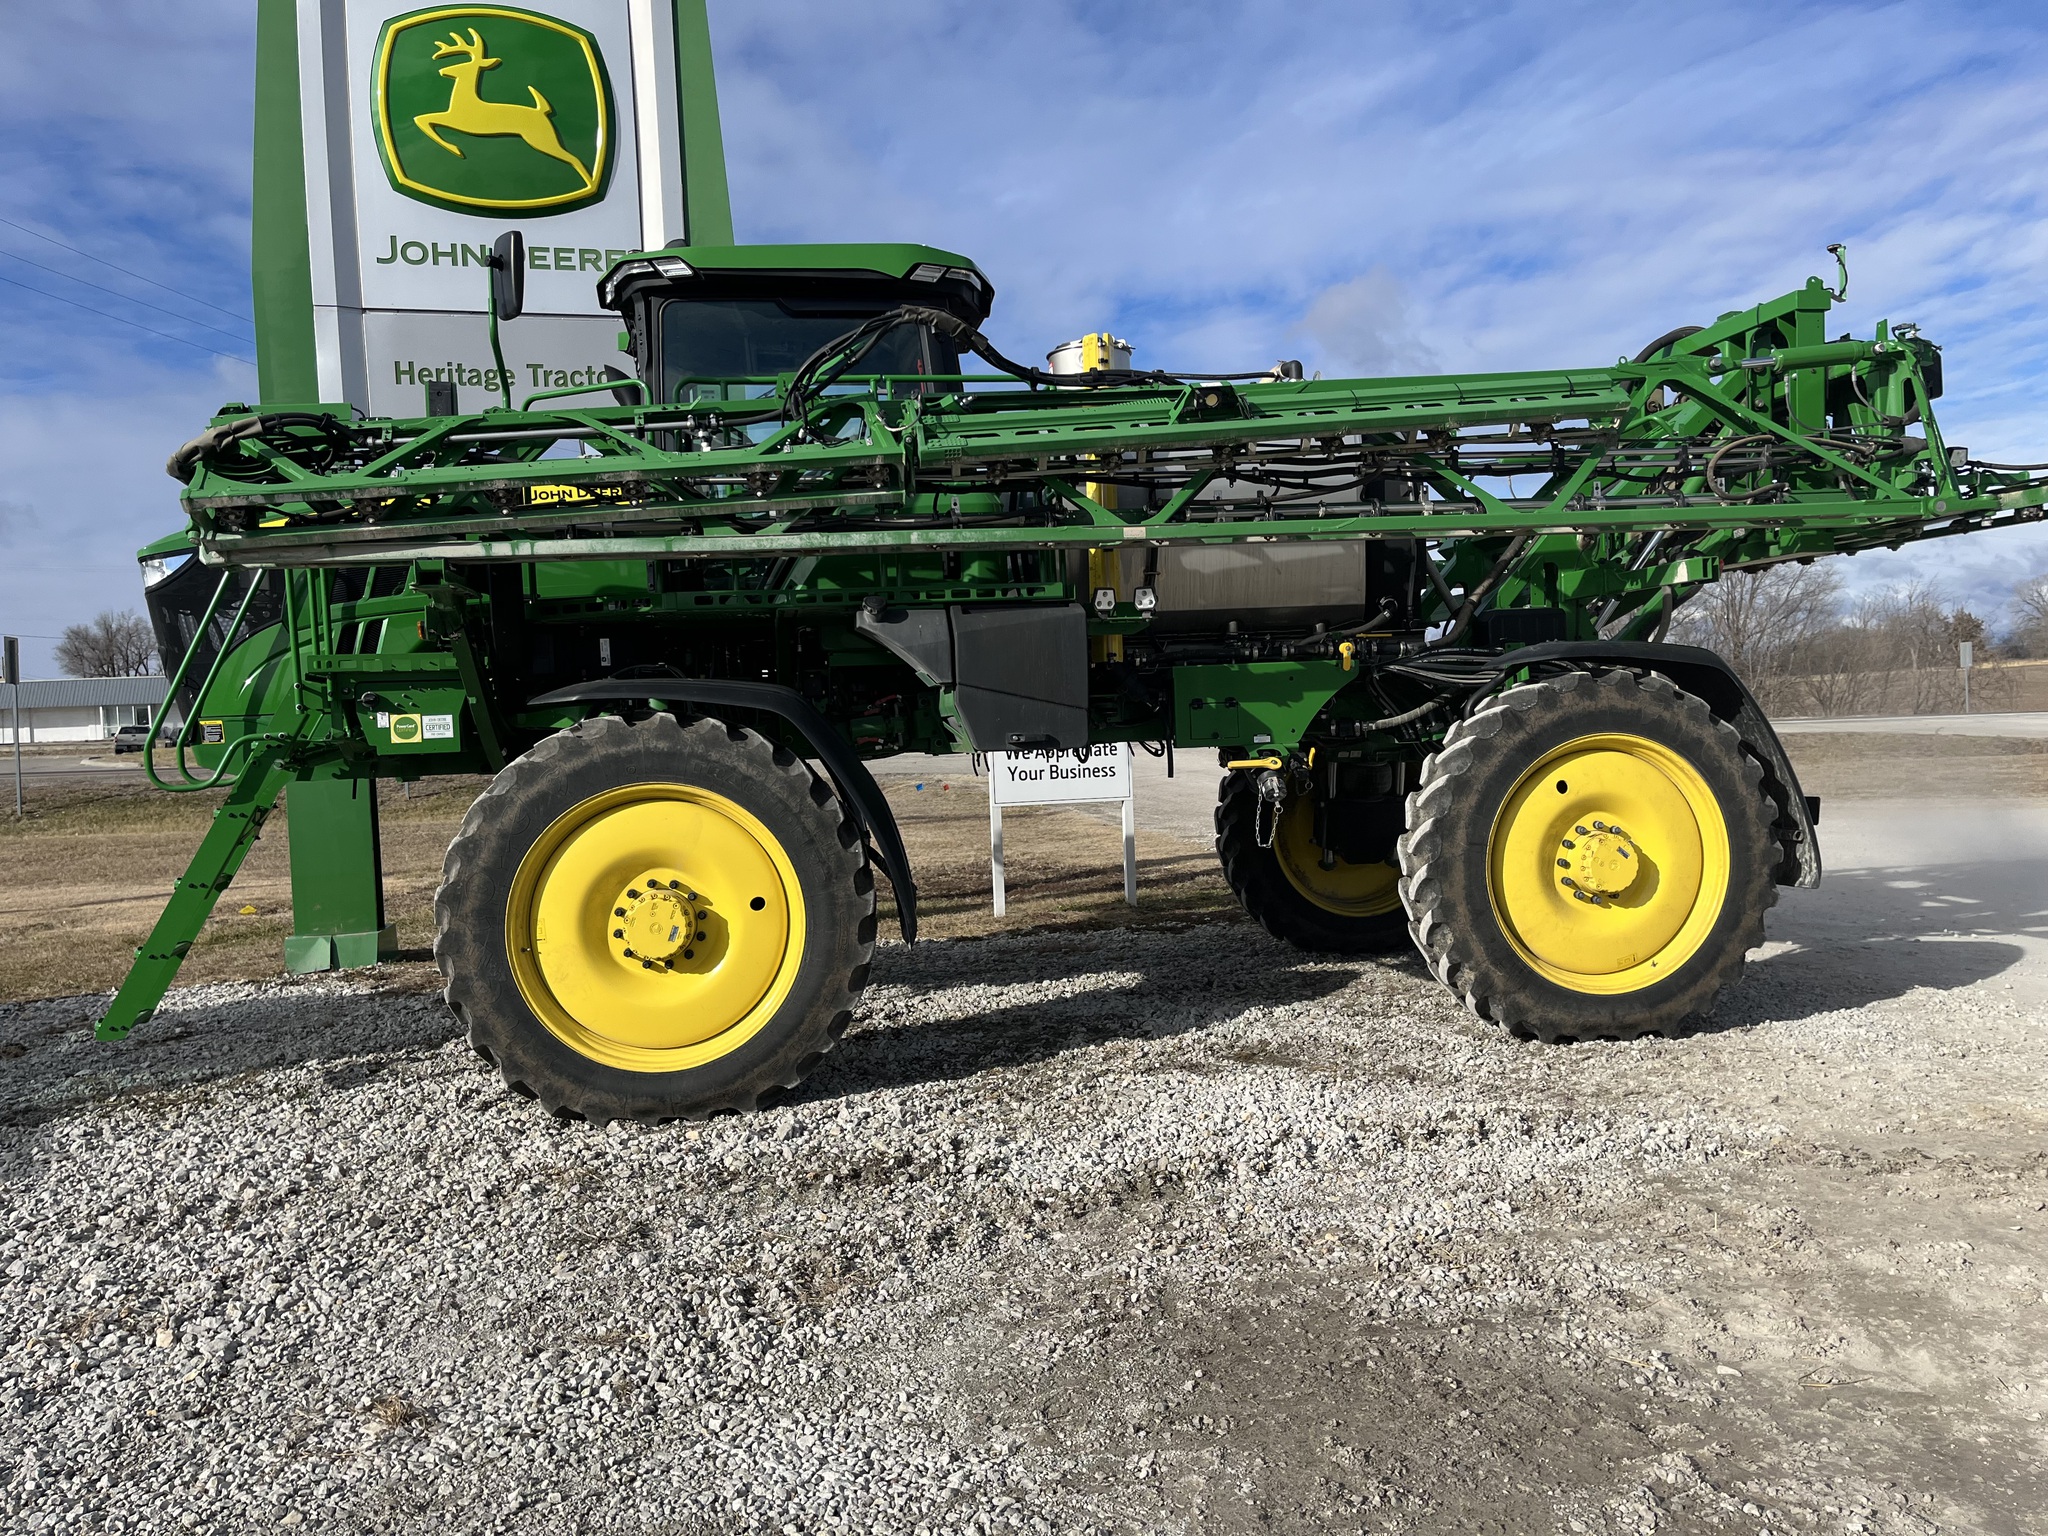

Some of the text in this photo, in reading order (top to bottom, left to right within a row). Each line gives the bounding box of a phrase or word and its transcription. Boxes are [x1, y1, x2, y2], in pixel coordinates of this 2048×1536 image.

[376, 235, 627, 272] JOHN EERE
[394, 360, 609, 392] Heritage Tracto
[531, 489, 573, 501] JOHN
[1006, 749, 1030, 760] We
[1007, 764, 1116, 781] Your Business
